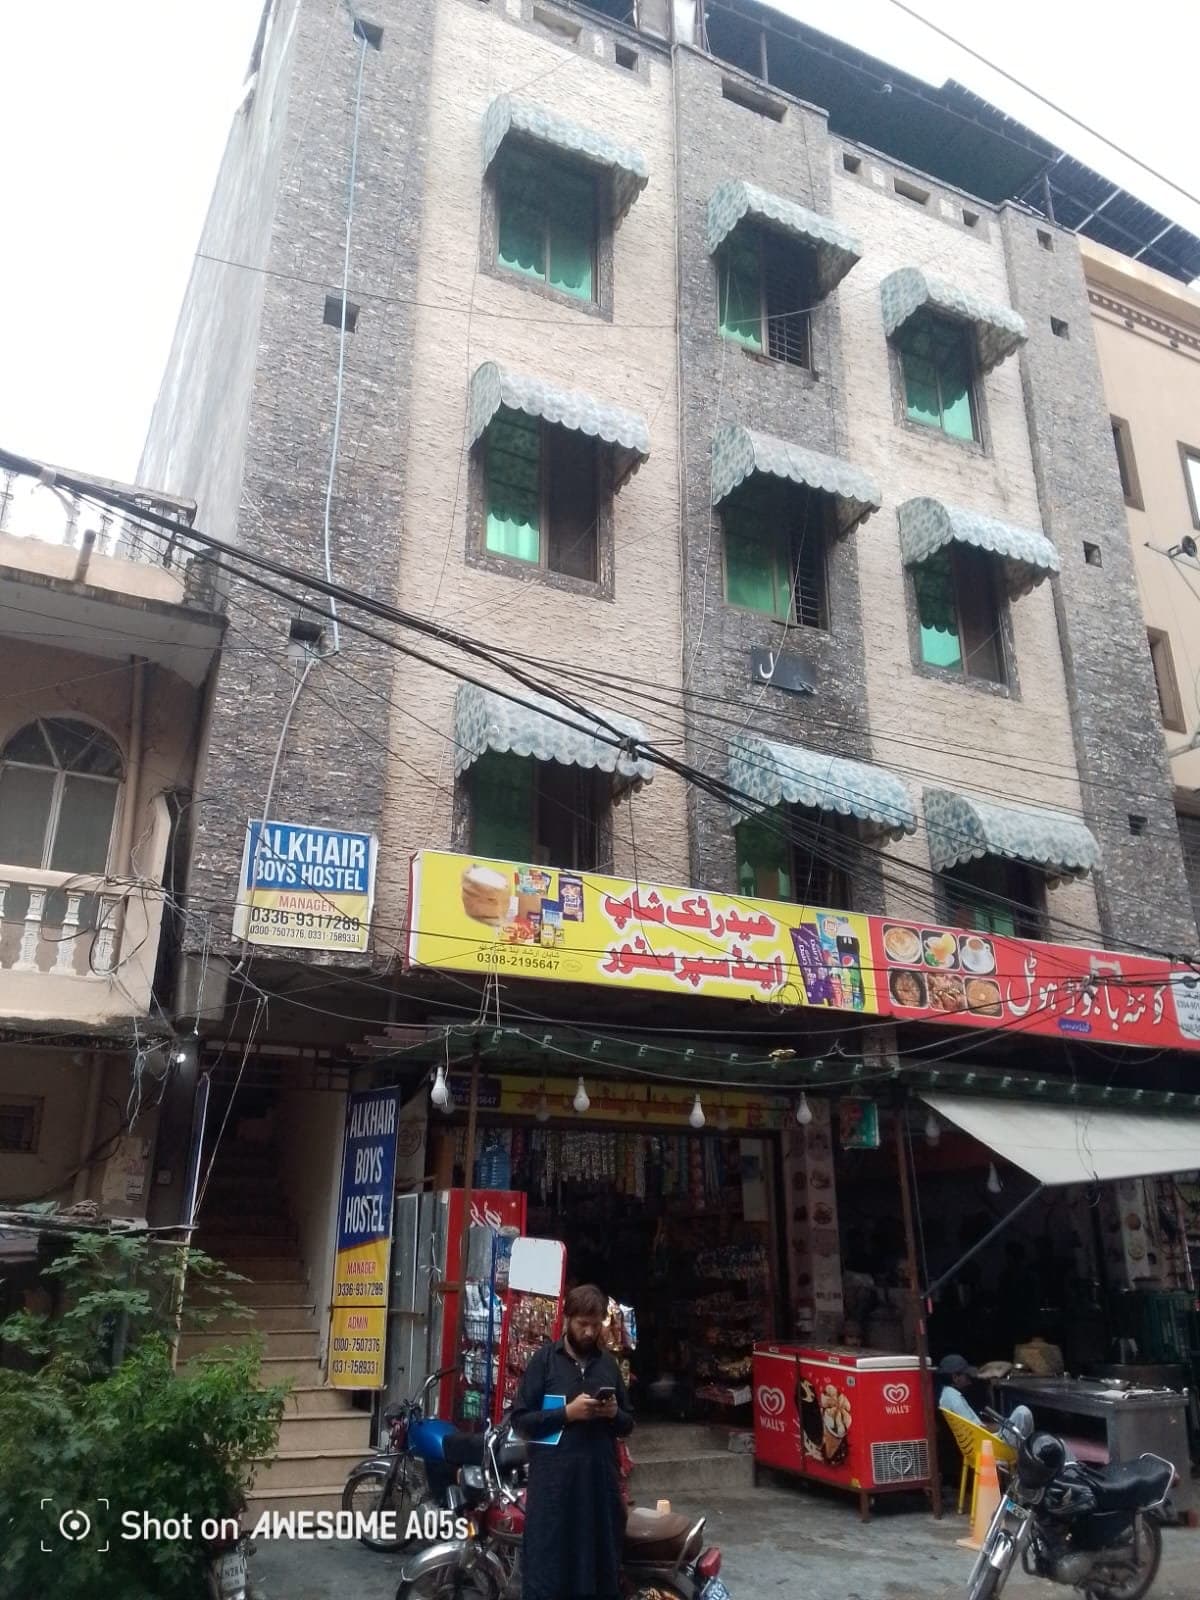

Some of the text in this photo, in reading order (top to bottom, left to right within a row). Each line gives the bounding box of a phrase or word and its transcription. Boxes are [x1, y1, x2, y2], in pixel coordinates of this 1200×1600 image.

[254, 829, 365, 869] ALKHAIR
[253, 859, 363, 891] BOYS HOSTEL
[251, 907, 360, 931] 0336-9317289
[278, 895, 337, 913] MANAGER
[605, 890, 665, 929] شاپ
[477, 952, 560, 971] 0308-2195647
[731, 944, 783, 989] اینڈ
[1006, 951, 1058, 1017] ہوٹل
[350, 1099, 396, 1138] ALKHAIR
[354, 1146, 384, 1185] BOYS
[344, 1194, 385, 1234] HOSTEL
[346, 1261, 376, 1275] MANAGER
[347, 1315, 369, 1330] ADMIN
[760, 1415, 786, 1432] WALL'S
[886, 1405, 910, 1415] WALL'S
